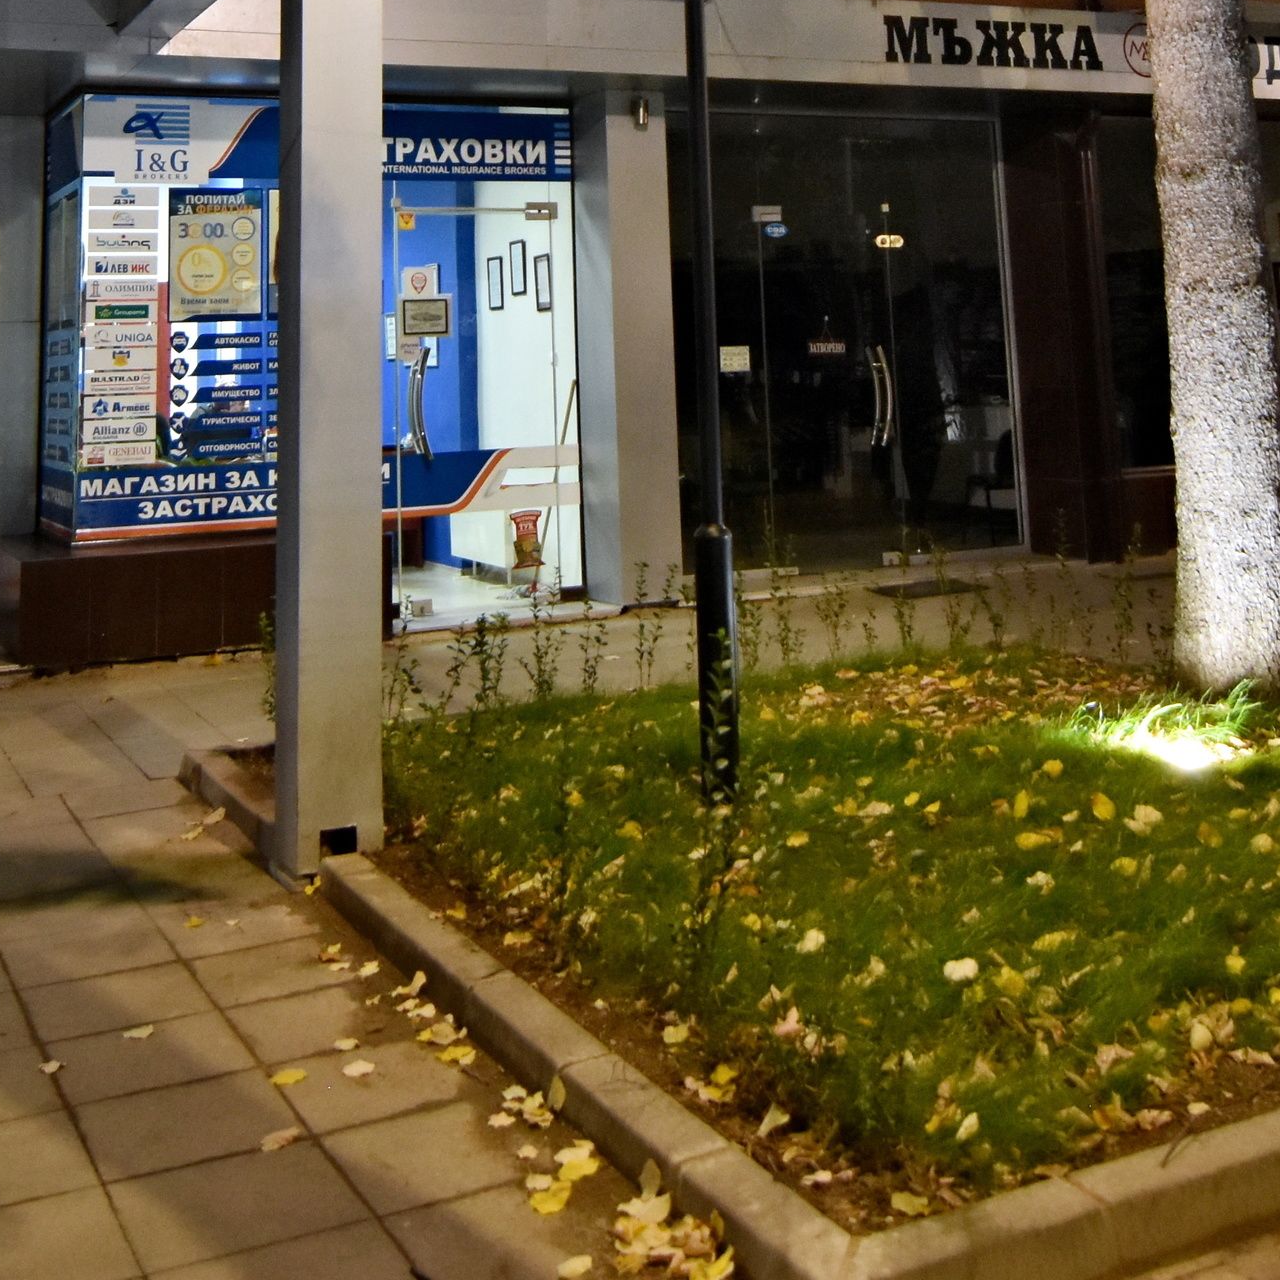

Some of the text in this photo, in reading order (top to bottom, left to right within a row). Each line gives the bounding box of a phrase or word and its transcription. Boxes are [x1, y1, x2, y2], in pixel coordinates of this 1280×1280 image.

[883, 14, 1103, 71] МЪЖКА
[382, 137, 547, 165] ТРАХОВКИ
[135, 149, 190, 173] I&G
[382, 164, 547, 175] NTERNATIONAL INSURANCE BROKERS
[185, 192, 246, 205] ПОПИТАЙ
[177, 204, 194, 215] ЗА
[110, 263, 150, 273] ЛЕВ ИНС
[105, 284, 156, 293] ОЛИМПИК
[115, 333, 154, 343] UNIQA
[214, 336, 260, 345] АВТОКАСКО
[232, 362, 260, 371] ЖИВОТ
[90, 375, 140, 383] BULSTRAD
[211, 389, 260, 399] ИМУЩЕСТВО
[202, 415, 261, 426] ТУРИСТИЧЕСКИ
[92, 425, 131, 436] Allianz
[199, 441, 261, 452] ОТГОВОРНОСТИ
[80, 473, 216, 497] МАГАЗИН
[225, 470, 260, 488] ЗА
[138, 493, 277, 519] ЗАСТРАХ
